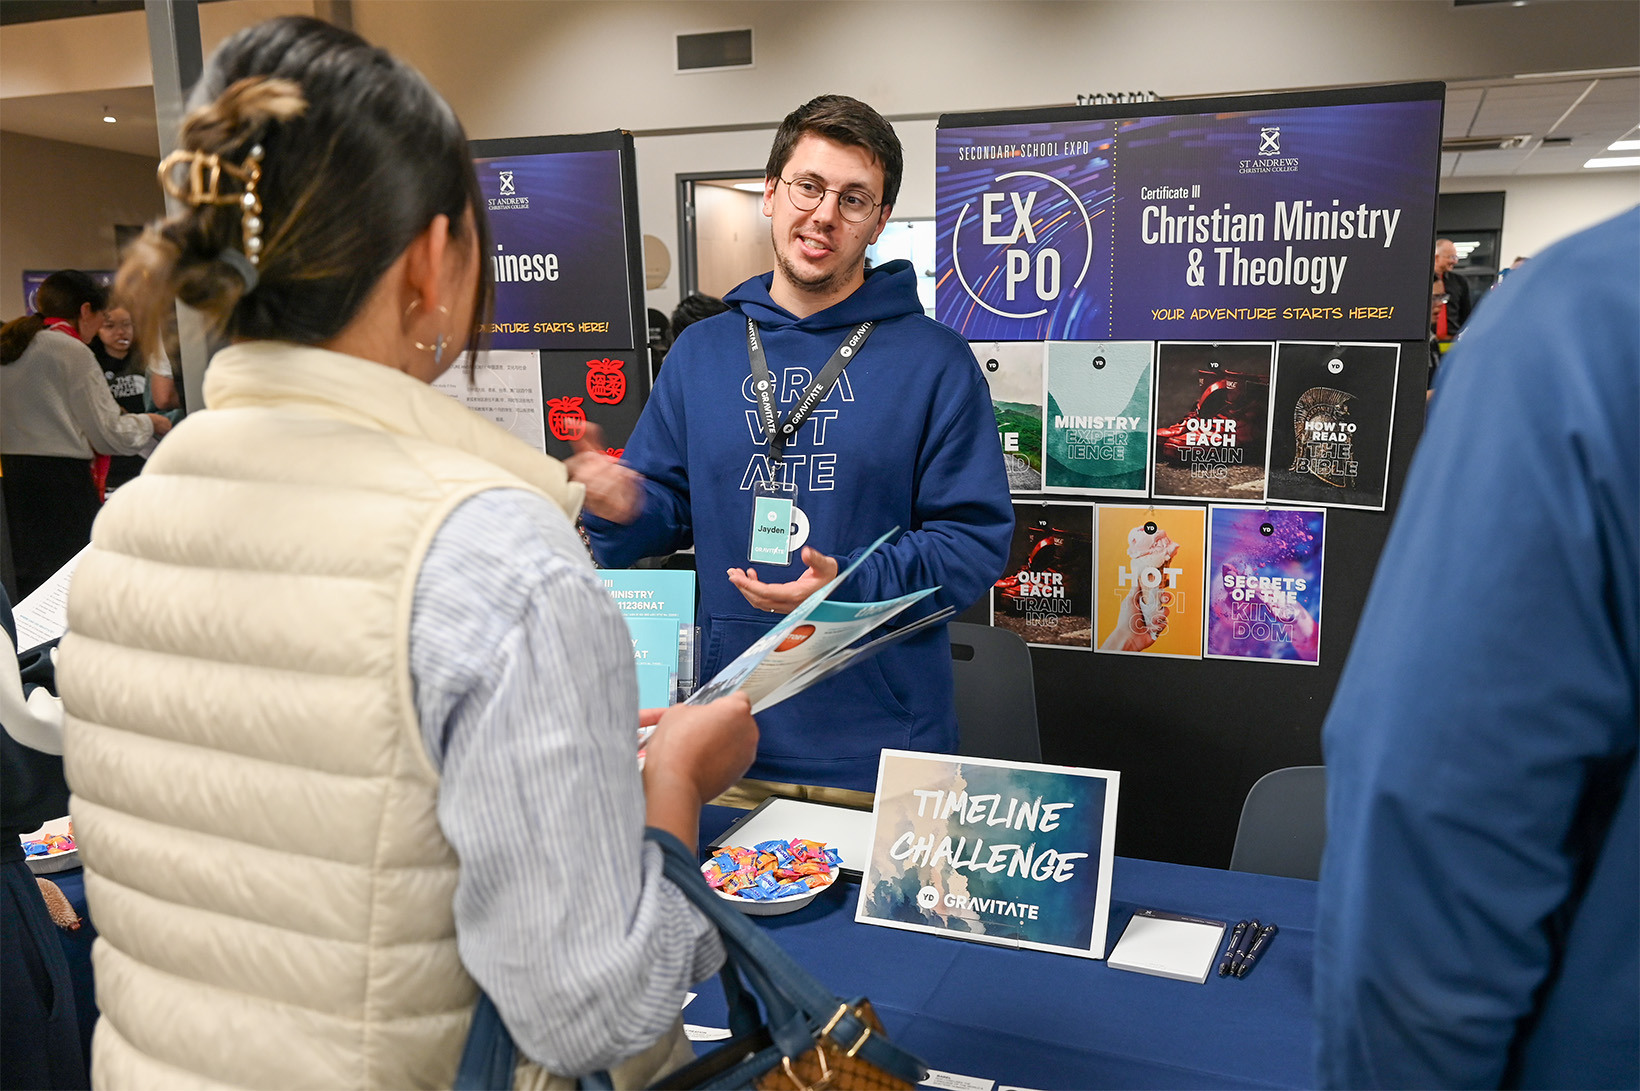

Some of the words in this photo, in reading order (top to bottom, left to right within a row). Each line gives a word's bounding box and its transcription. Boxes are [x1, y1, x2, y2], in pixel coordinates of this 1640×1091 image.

[959, 145, 1016, 161] SECONDARY
[1020, 142, 1059, 157] SCHOOL
[1064, 140, 1089, 155] EXPO
[1239, 160, 1251, 168] ST
[1252, 158, 1299, 167] ANDREWS
[1141, 186, 1189, 200] Certificate
[1192, 184, 1201, 198] III
[497, 197, 529, 205] ANDREWS
[1141, 203, 1265, 244] Christian
[1273, 199, 1401, 248] Ministry
[490, 244, 559, 282] inese
[1186, 248, 1205, 287] &
[1214, 246, 1347, 294] Theology
[1151, 308, 1185, 321] YOUR
[1190, 307, 1277, 321] ADVENTURE
[1282, 307, 1343, 320] STARTS
[1349, 306, 1395, 320] HERE!
[533, 322, 576, 333] STARTS
[578, 321, 610, 333] HERE!
[792, 383, 824, 425] GRAVITATE
[761, 391, 777, 434] GRAVITATE
[1055, 415, 1141, 430] MINISTRY
[1186, 418, 1237, 433] OUTR
[1305, 420, 1335, 431] HOW
[1339, 422, 1357, 433] TO
[1066, 429, 1128, 445] EXPER
[1185, 433, 1236, 447] EACH
[1312, 431, 1347, 442] READ
[1068, 445, 1125, 461] IENCE
[1178, 446, 1243, 463] TRAIN
[1306, 441, 1352, 460] THE
[739, 453, 837, 492] ATE
[1191, 463, 1228, 479] ING
[1296, 457, 1359, 477] BIBLE
[758, 525, 785, 534] Jayden
[1018, 571, 1063, 585] OUTR
[1118, 566, 1183, 589] HOT
[1223, 575, 1307, 591] SECRETS
[607, 590, 655, 599] MINISTRY
[1020, 585, 1065, 599] EACH
[1231, 588, 1256, 602] OF
[1260, 591, 1298, 604] THE
[618, 601, 665, 610] 11236NAT
[1013, 597, 1072, 613] TRAIN
[1114, 588, 1186, 614] TOPI
[1025, 612, 1059, 627] ING
[1231, 602, 1297, 624] KING
[1129, 612, 1170, 636] CS
[1232, 620, 1294, 643] DOM
[913, 788, 1074, 833] TIMELINE
[889, 831, 1089, 883] CHALLENGE
[922, 892, 935, 902] YD
[943, 893, 1040, 920] GRAVITATE
